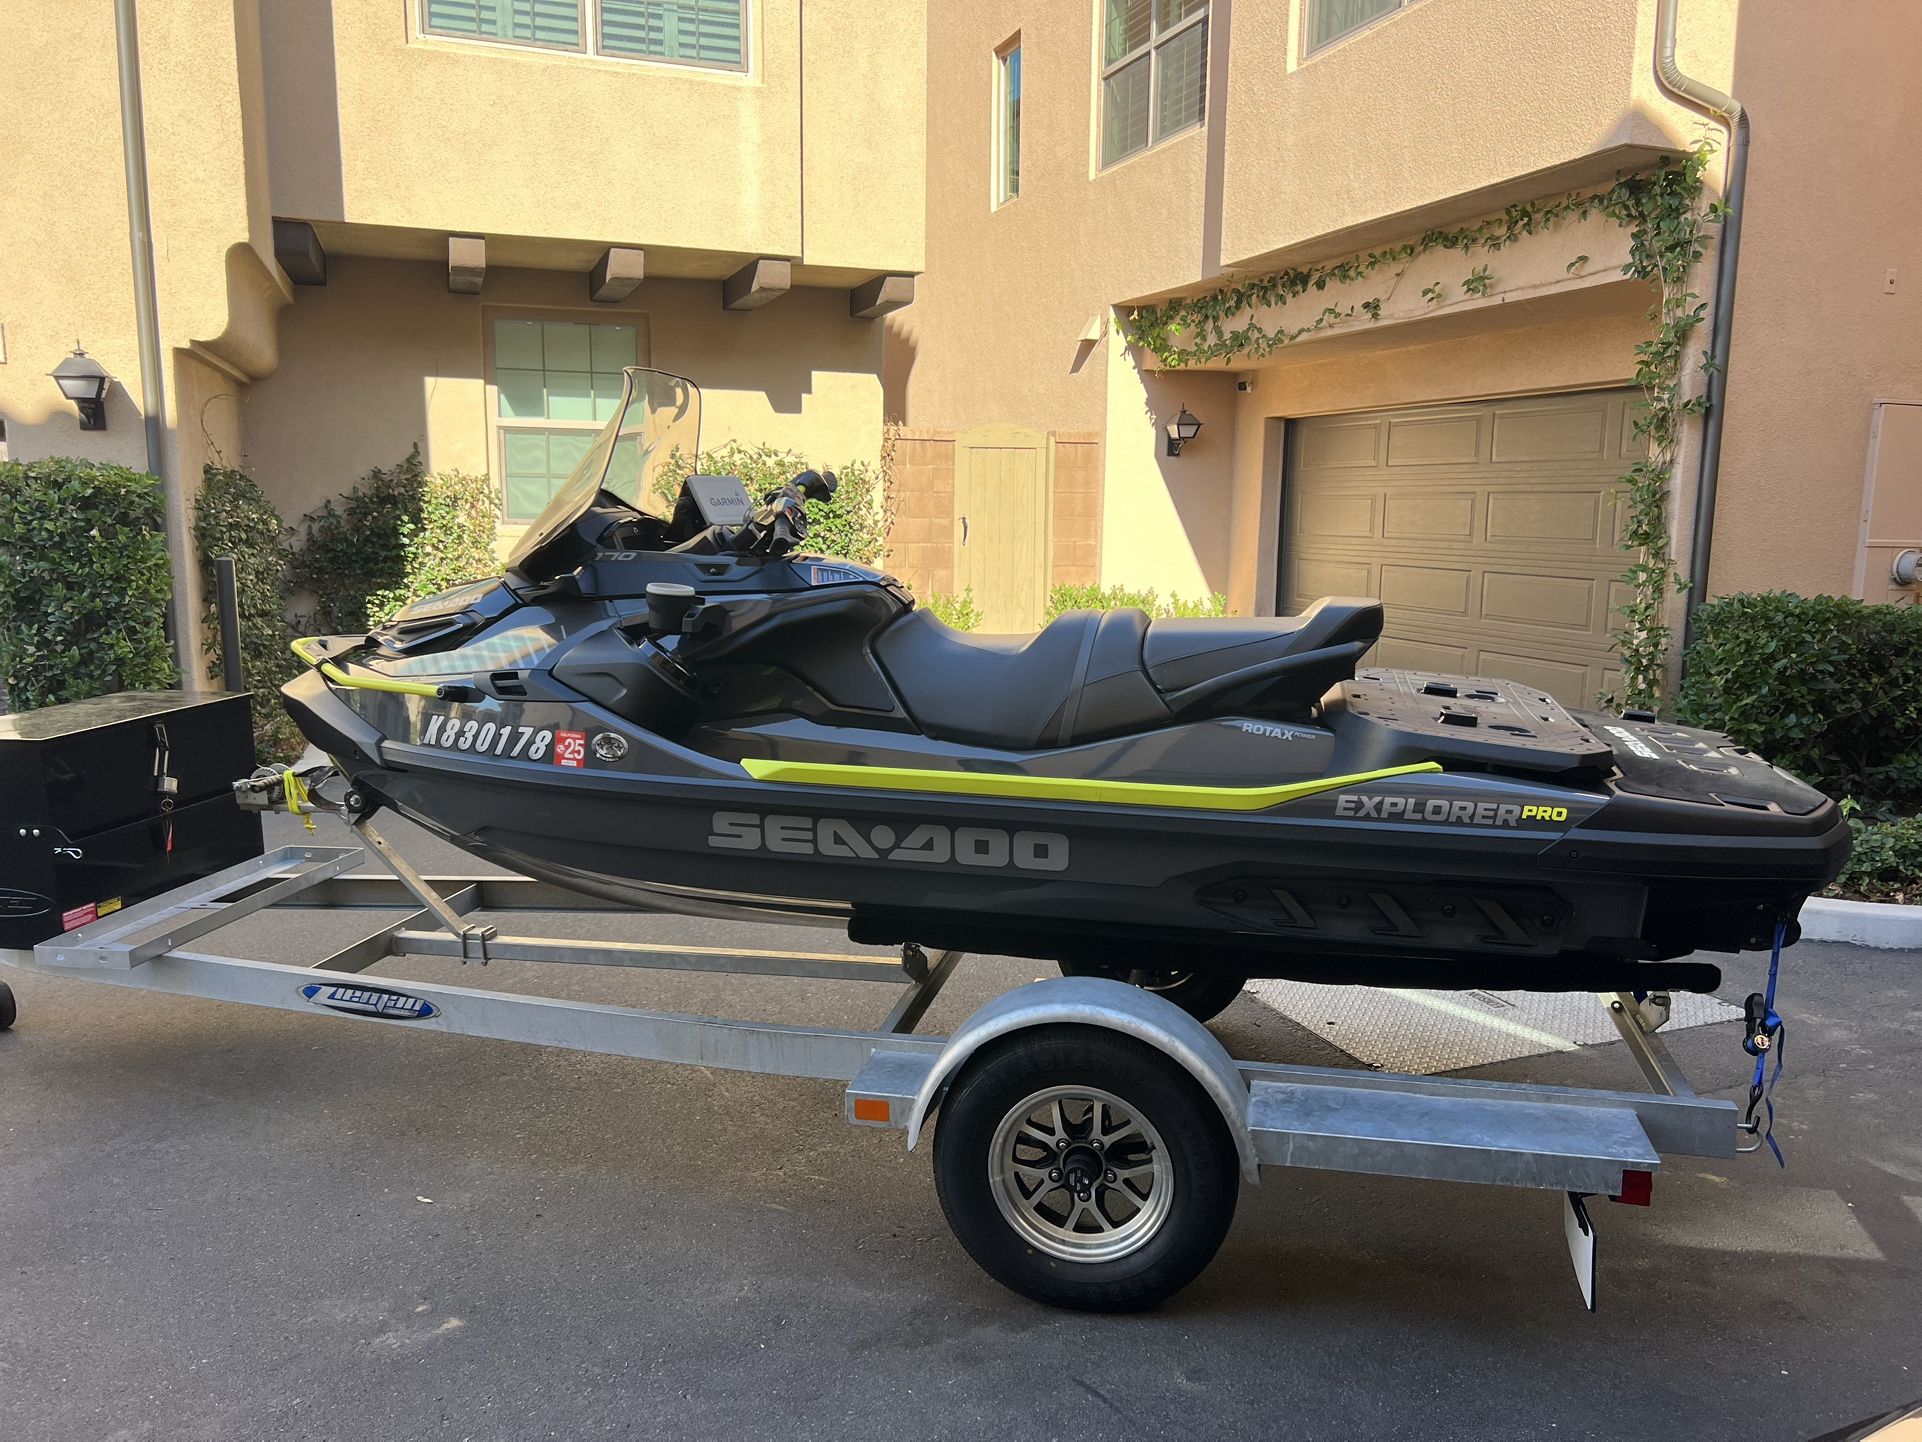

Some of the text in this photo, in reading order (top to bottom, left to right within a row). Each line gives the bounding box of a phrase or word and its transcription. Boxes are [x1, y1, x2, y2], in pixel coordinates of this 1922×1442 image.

[709, 496, 745, 507] GARMIN
[594, 552, 638, 561] 170
[423, 714, 553, 761] K830178
[1242, 722, 1294, 741] ROTAX
[564, 738, 585, 759] 25
[1335, 794, 1568, 827] EXPLORER PRO
